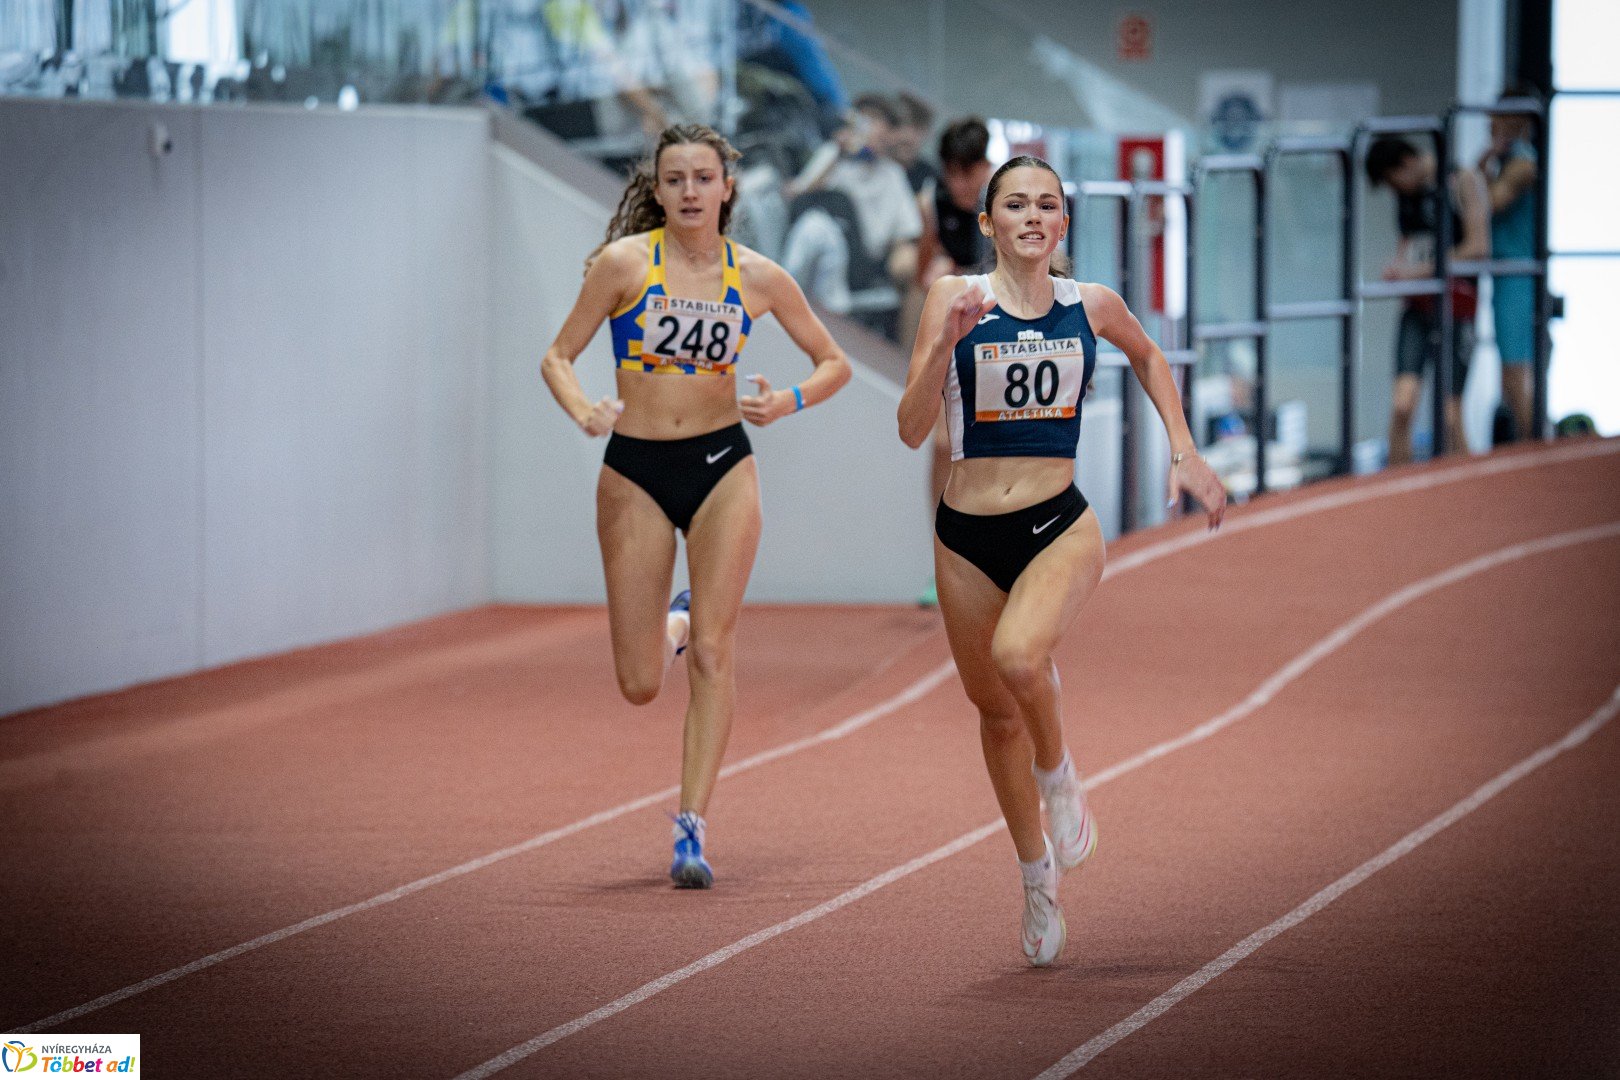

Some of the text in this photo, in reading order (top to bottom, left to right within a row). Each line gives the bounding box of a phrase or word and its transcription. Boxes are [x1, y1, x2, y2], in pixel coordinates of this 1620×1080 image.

[670, 298, 737, 314] STABILITA
[655, 315, 730, 362] 248
[1000, 340, 1075, 355] STABILITA
[1004, 360, 1059, 408] 80
[998, 408, 1063, 420] ATLETIKA
